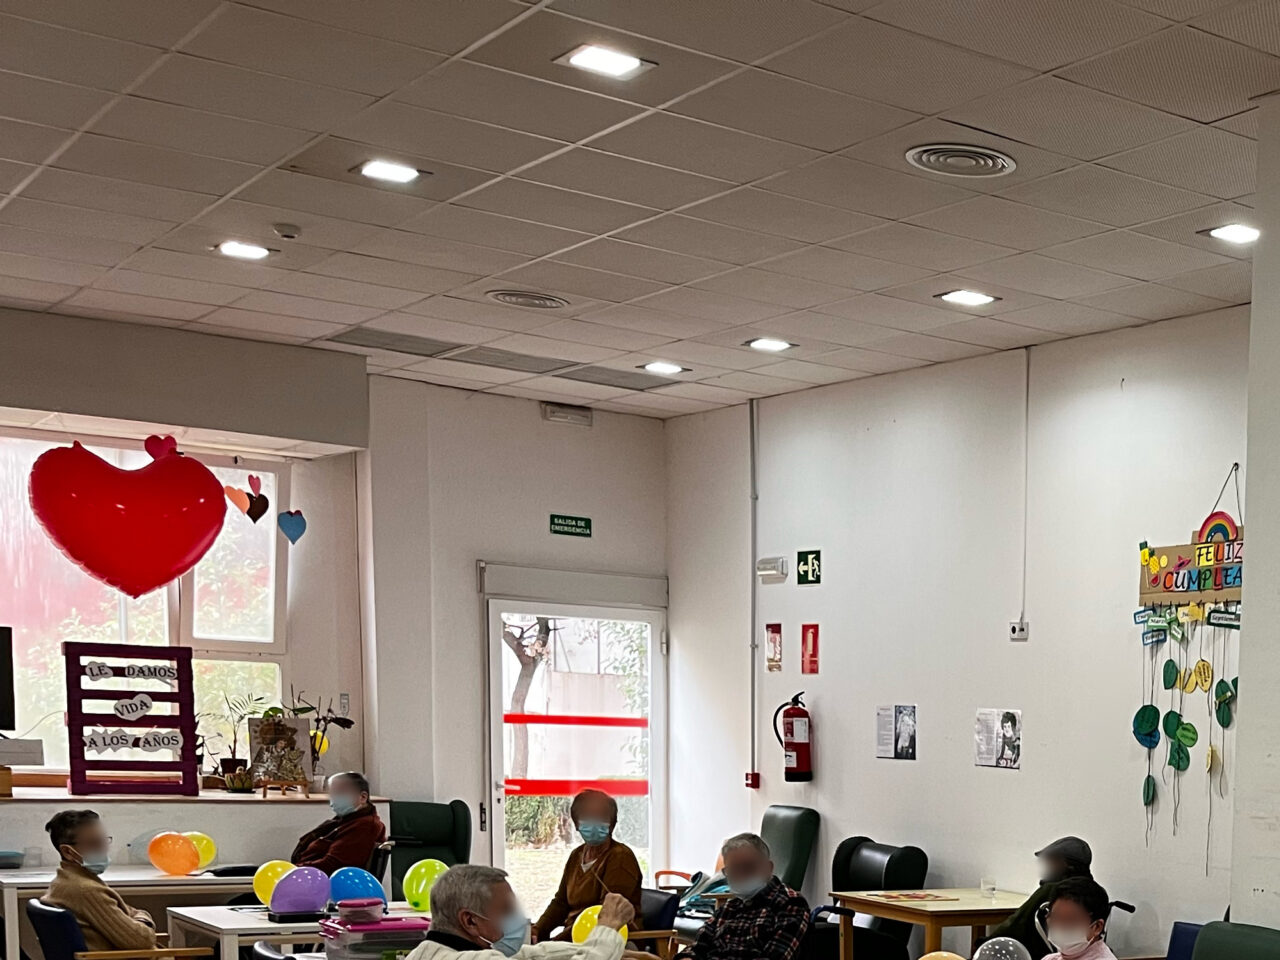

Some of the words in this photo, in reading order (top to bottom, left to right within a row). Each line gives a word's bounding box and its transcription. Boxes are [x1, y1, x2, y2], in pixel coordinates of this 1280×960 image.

[551, 525, 590, 534] EMERGENCIA
[1195, 542, 1244, 567] FELIZ
[89, 665, 108, 678] LE
[126, 665, 176, 678] DAMOS
[115, 700, 150, 717] VIDA
[88, 737, 98, 748] A
[102, 735, 129, 747] LOS
[142, 734, 180, 748] AÑOS
